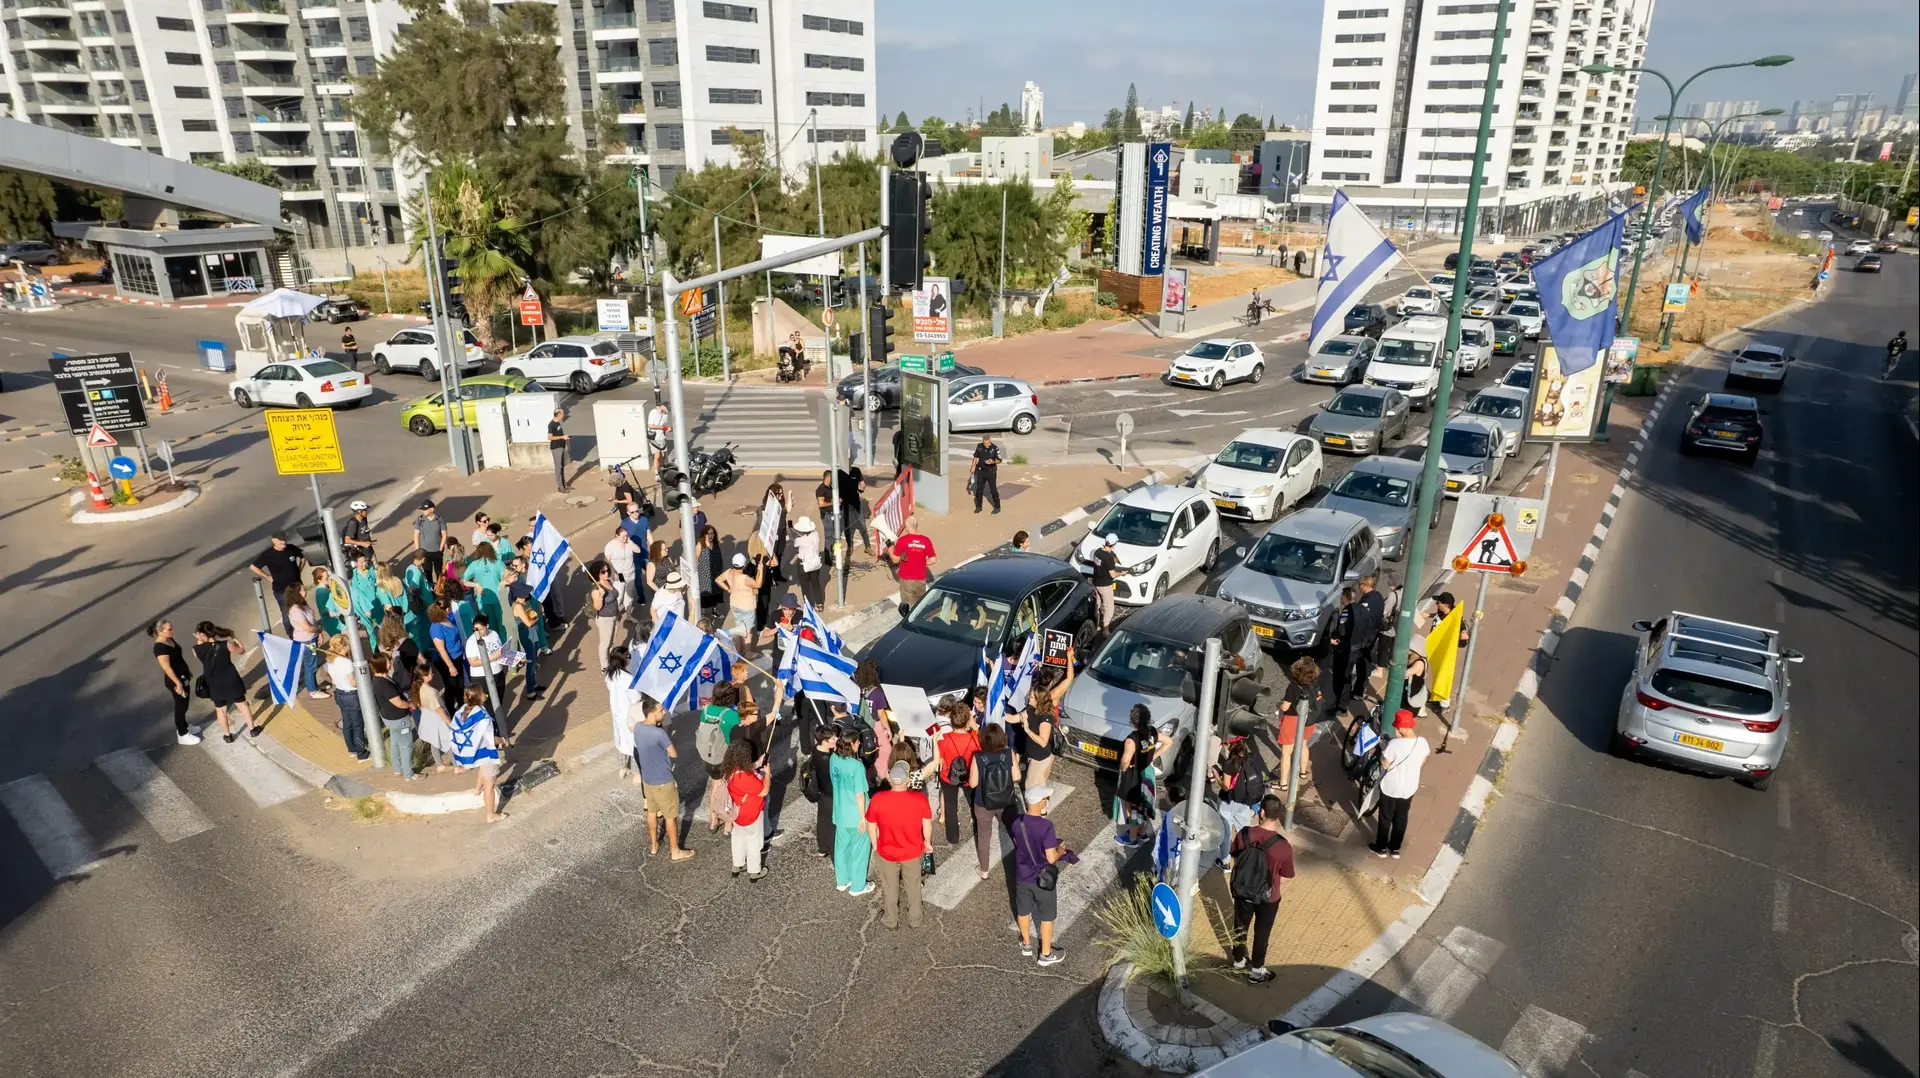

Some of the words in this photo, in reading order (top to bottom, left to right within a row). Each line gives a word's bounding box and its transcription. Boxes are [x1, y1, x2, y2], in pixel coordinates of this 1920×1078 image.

[1153, 186, 1164, 224] WEALTH
[1150, 226, 1162, 268] CREATING
[292, 424, 311, 432] בירוק
[1056, 634, 1067, 643] אל
[1050, 641, 1067, 650] תתנו
[1049, 648, 1057, 657] לו
[1045, 655, 1067, 665] להקריב
[358, 666, 368, 675] 13
